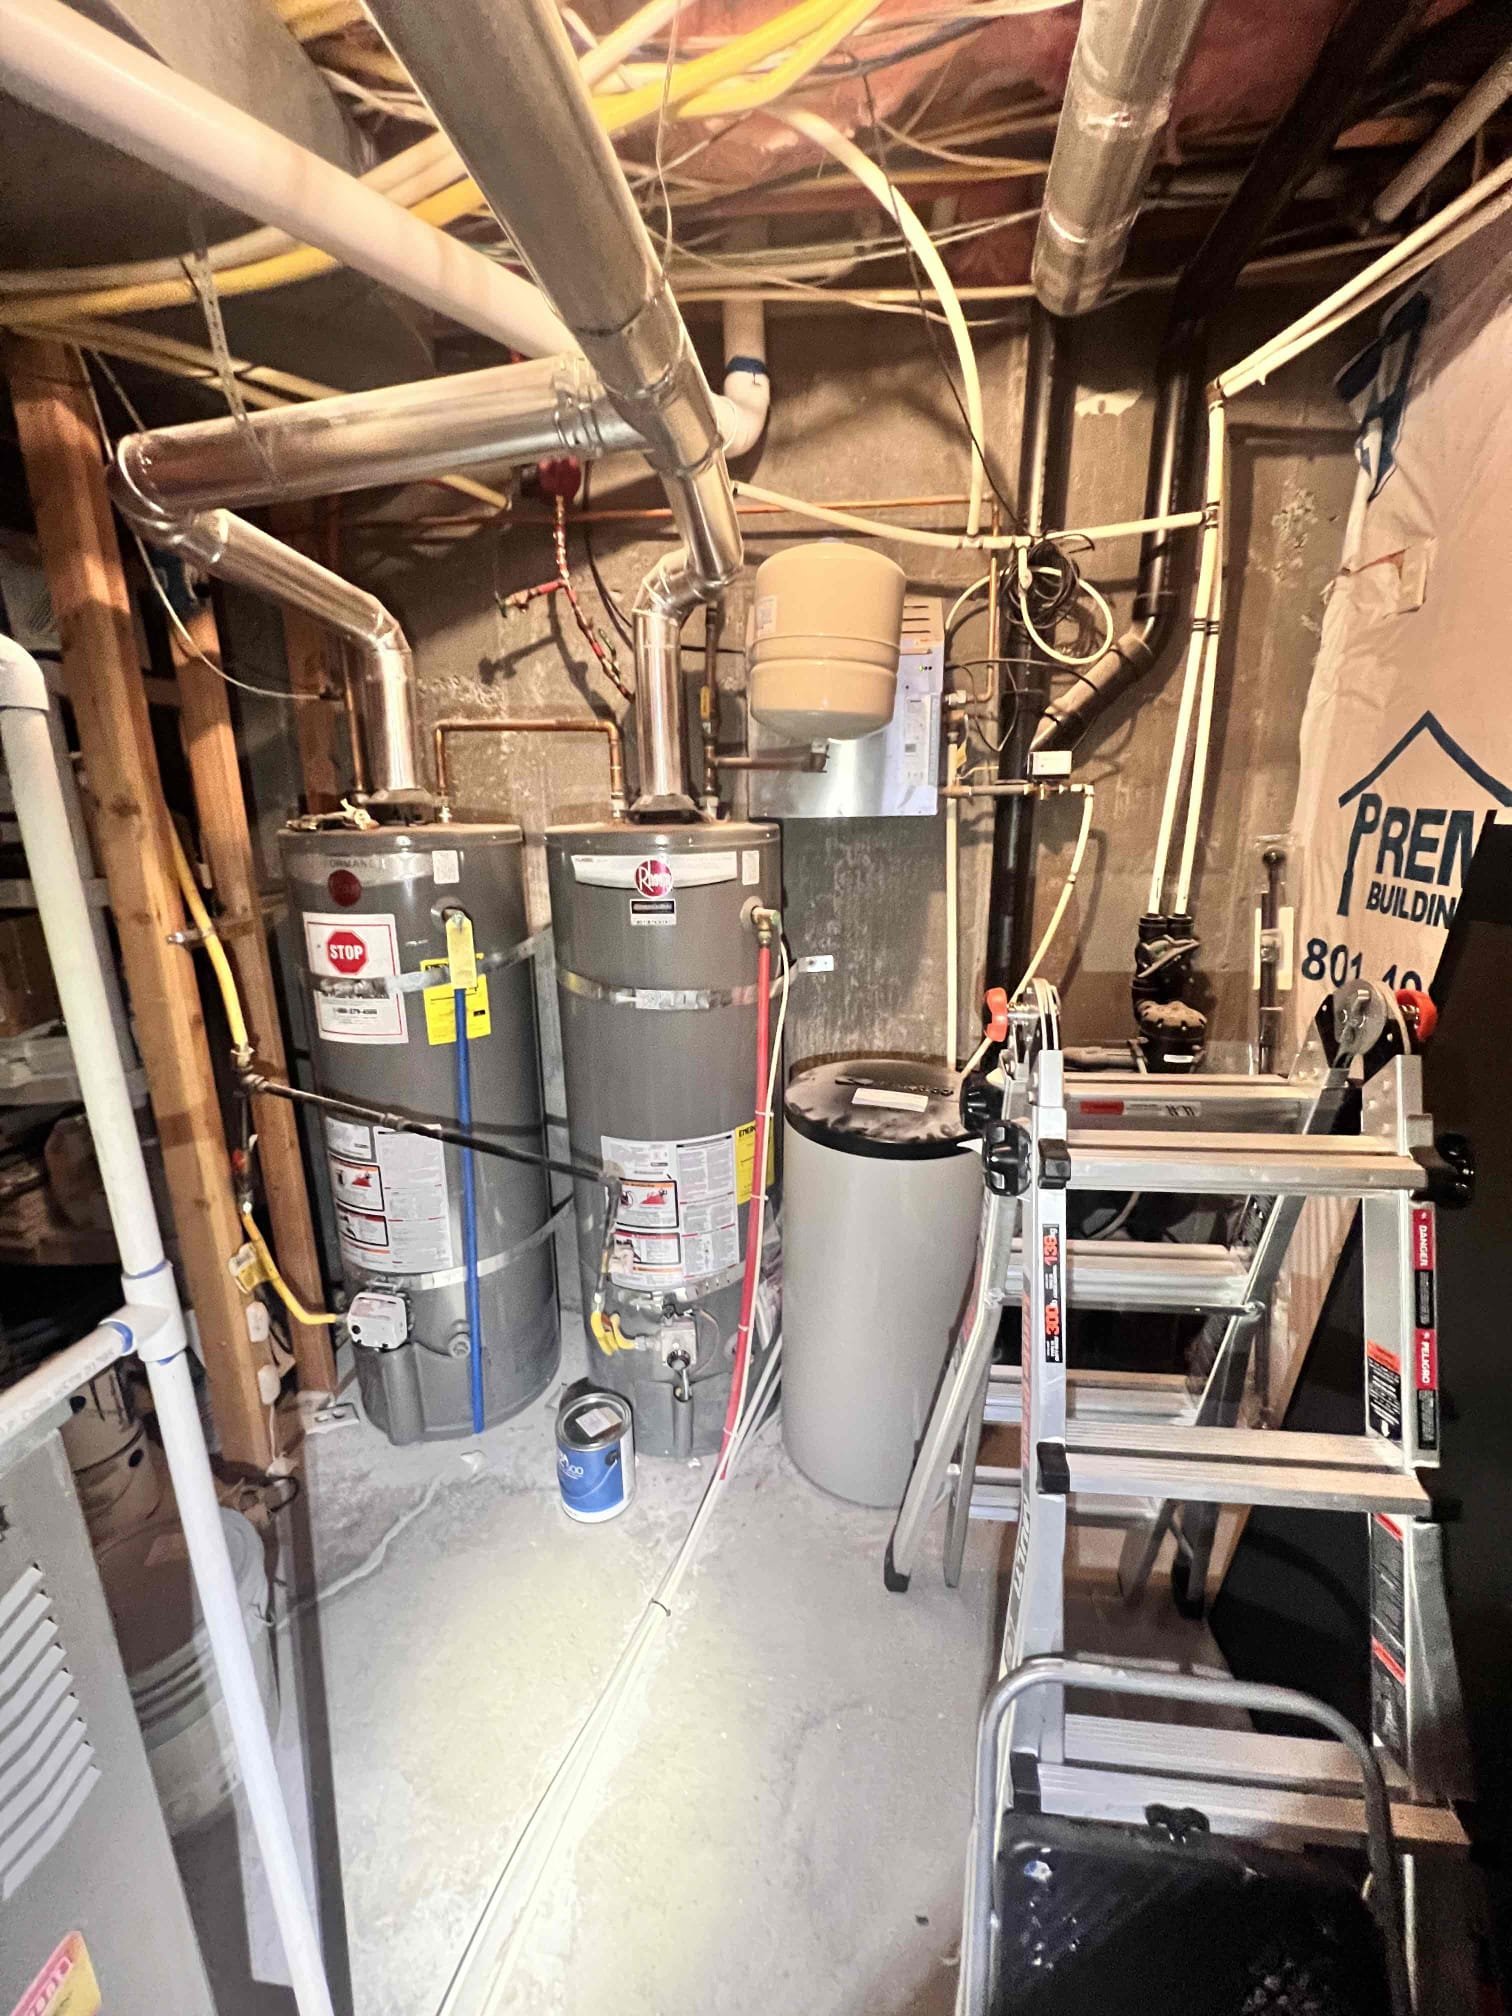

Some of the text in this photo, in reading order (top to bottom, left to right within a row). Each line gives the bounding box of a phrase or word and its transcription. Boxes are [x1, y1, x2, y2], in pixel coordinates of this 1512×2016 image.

[329, 944, 364, 960] STOP
[1418, 1225, 1428, 1267] DANGER
[1420, 1340, 1430, 1384] PELIGRO
